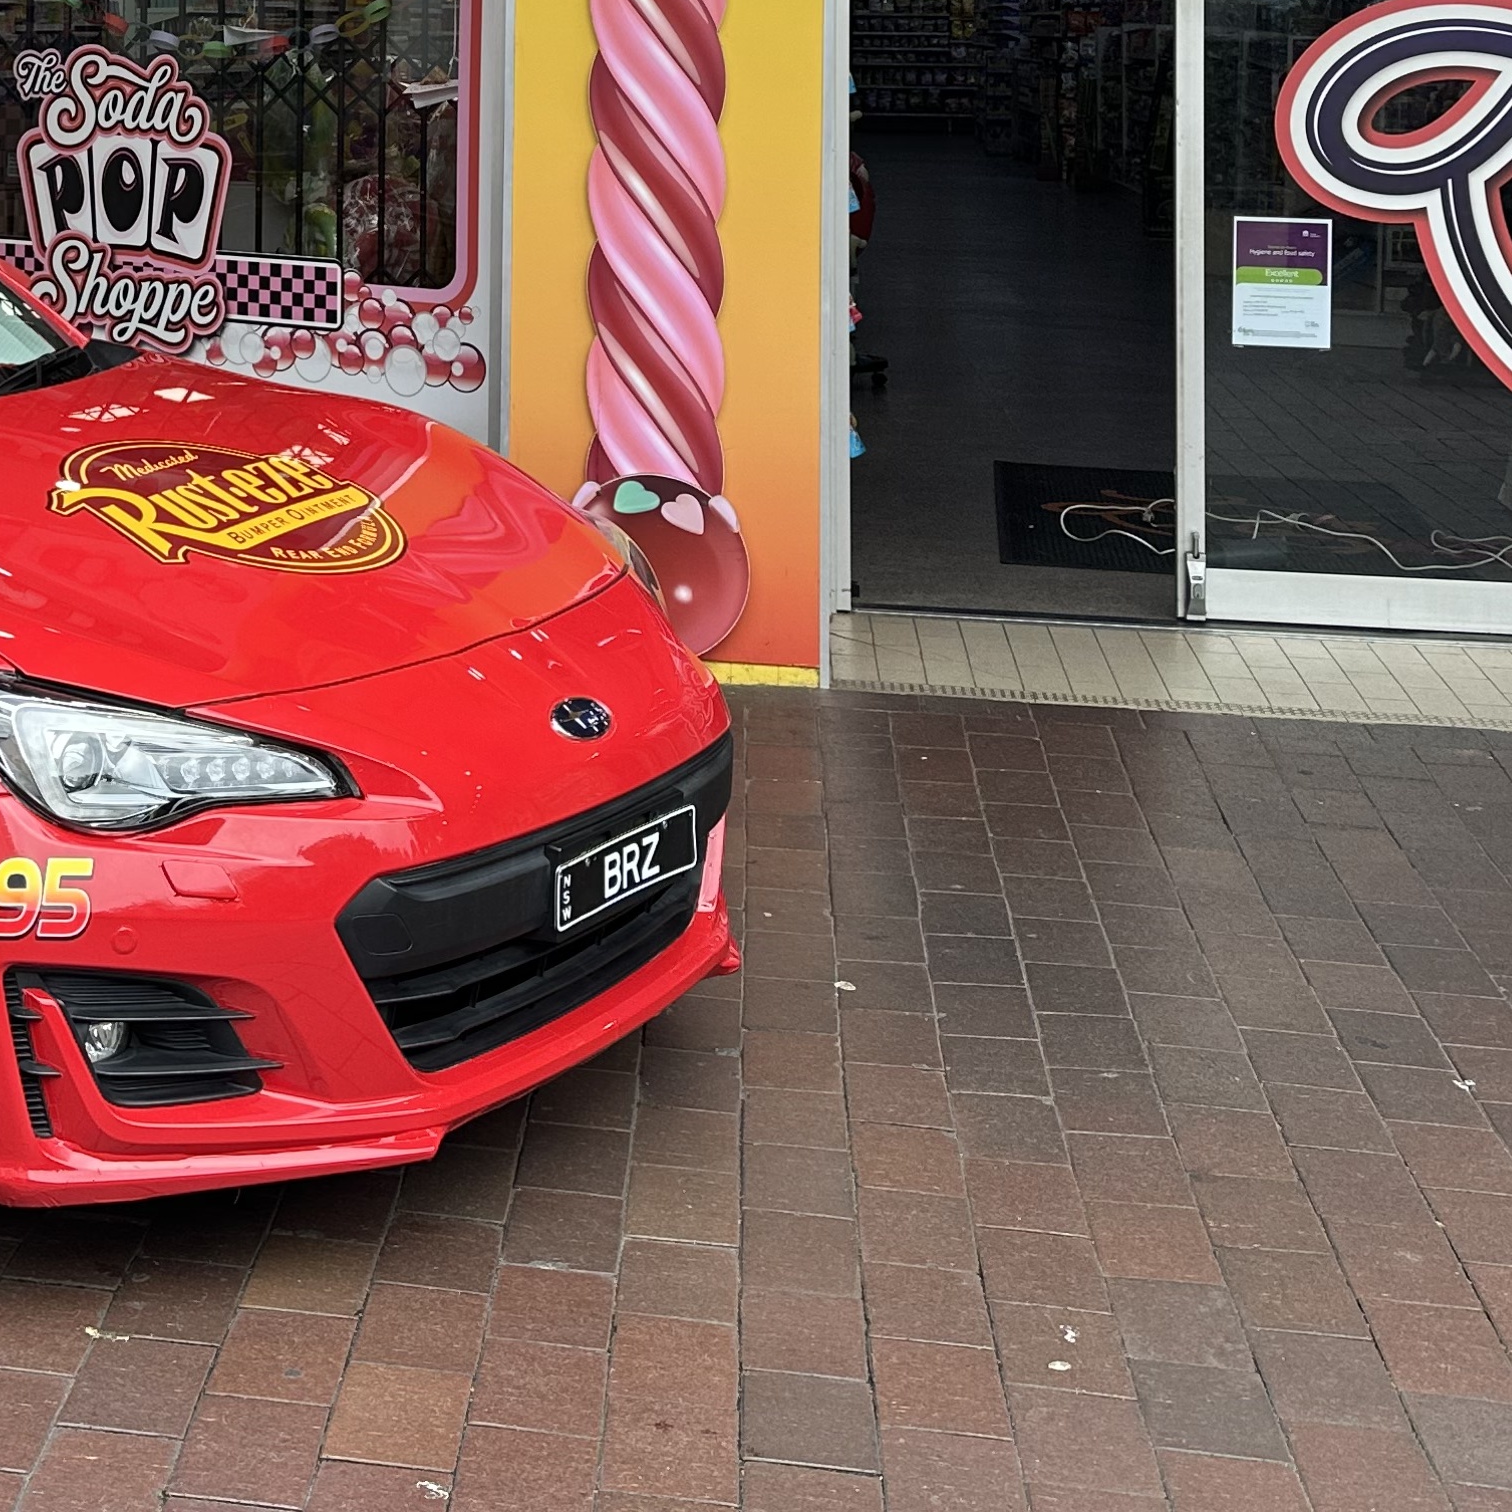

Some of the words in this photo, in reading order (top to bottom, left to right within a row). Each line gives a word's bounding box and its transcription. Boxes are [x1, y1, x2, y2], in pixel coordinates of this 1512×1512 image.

[18, 53, 67, 95] The
[45, 53, 205, 146] Soda
[36, 149, 206, 247] POP
[31, 238, 218, 343] Shoppe
[1265, 268, 1299, 278] Excellent
[99, 449, 199, 482] Medicated
[227, 515, 289, 544] BUMPER
[286, 494, 357, 520] OINTMENT
[270, 546, 324, 560] REAR
[320, 544, 359, 559] END
[604, 831, 661, 899] BRZ
[562, 873, 573, 922] NSW
